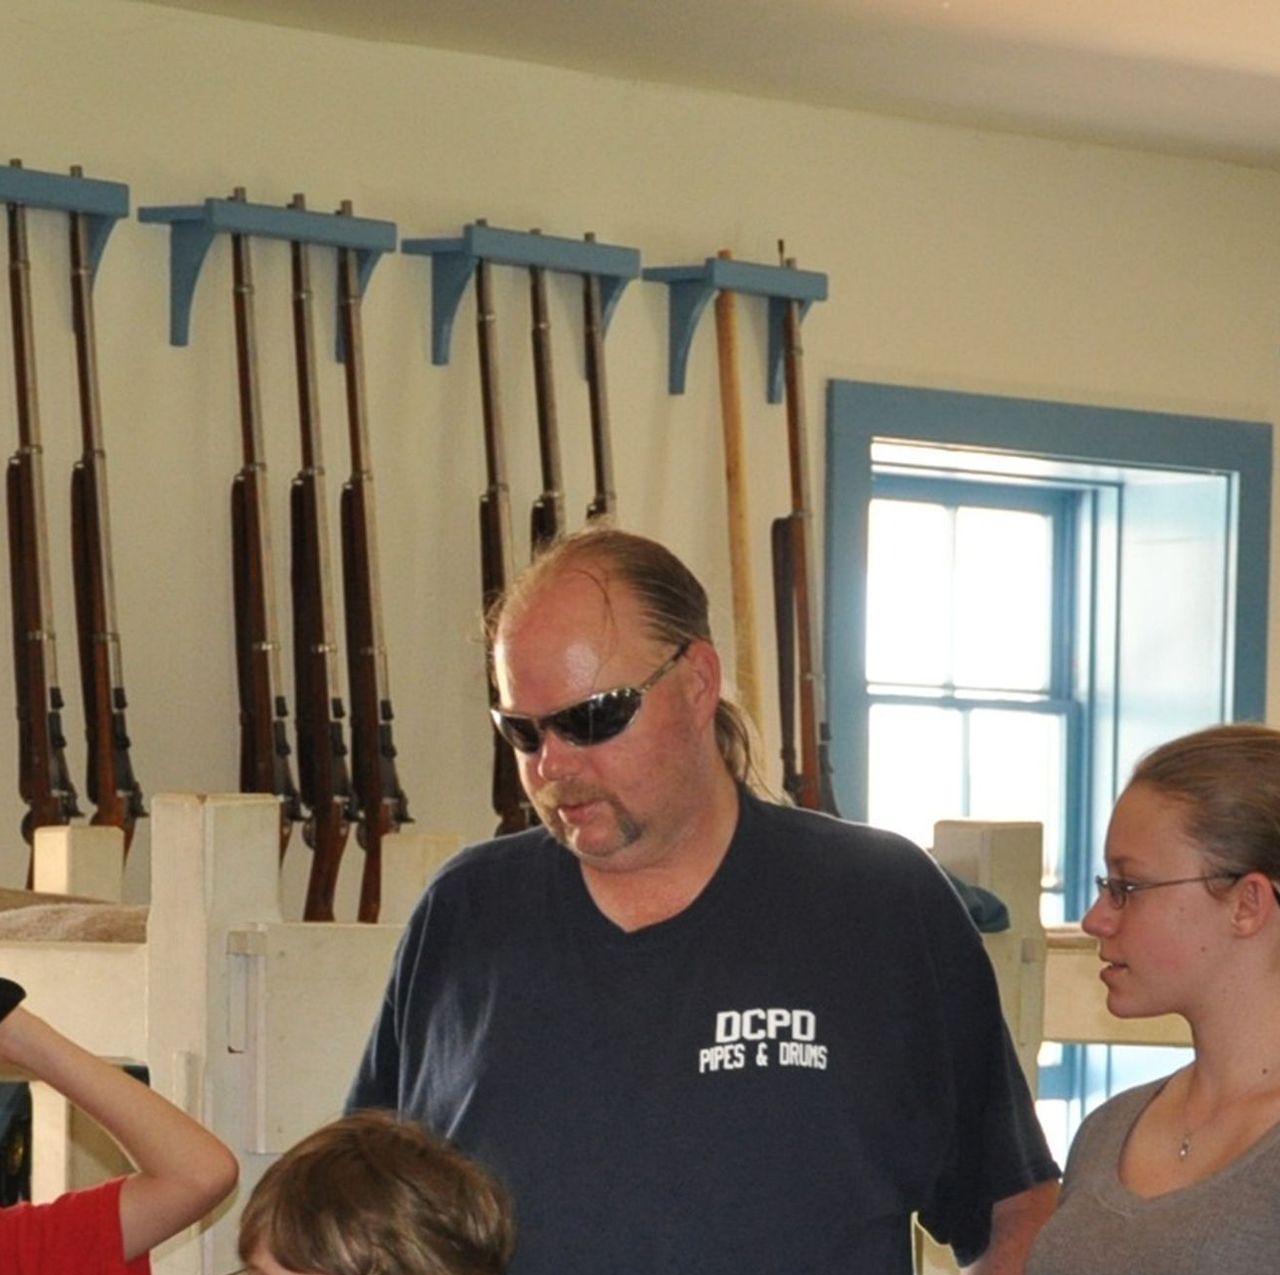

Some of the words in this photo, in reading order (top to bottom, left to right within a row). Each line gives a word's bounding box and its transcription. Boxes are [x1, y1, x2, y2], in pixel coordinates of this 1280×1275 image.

[715, 1007, 816, 1043] DCPD
[699, 1043, 745, 1073] PIPES
[755, 1041, 768, 1067] &
[779, 1042, 828, 1070] DRUMS
